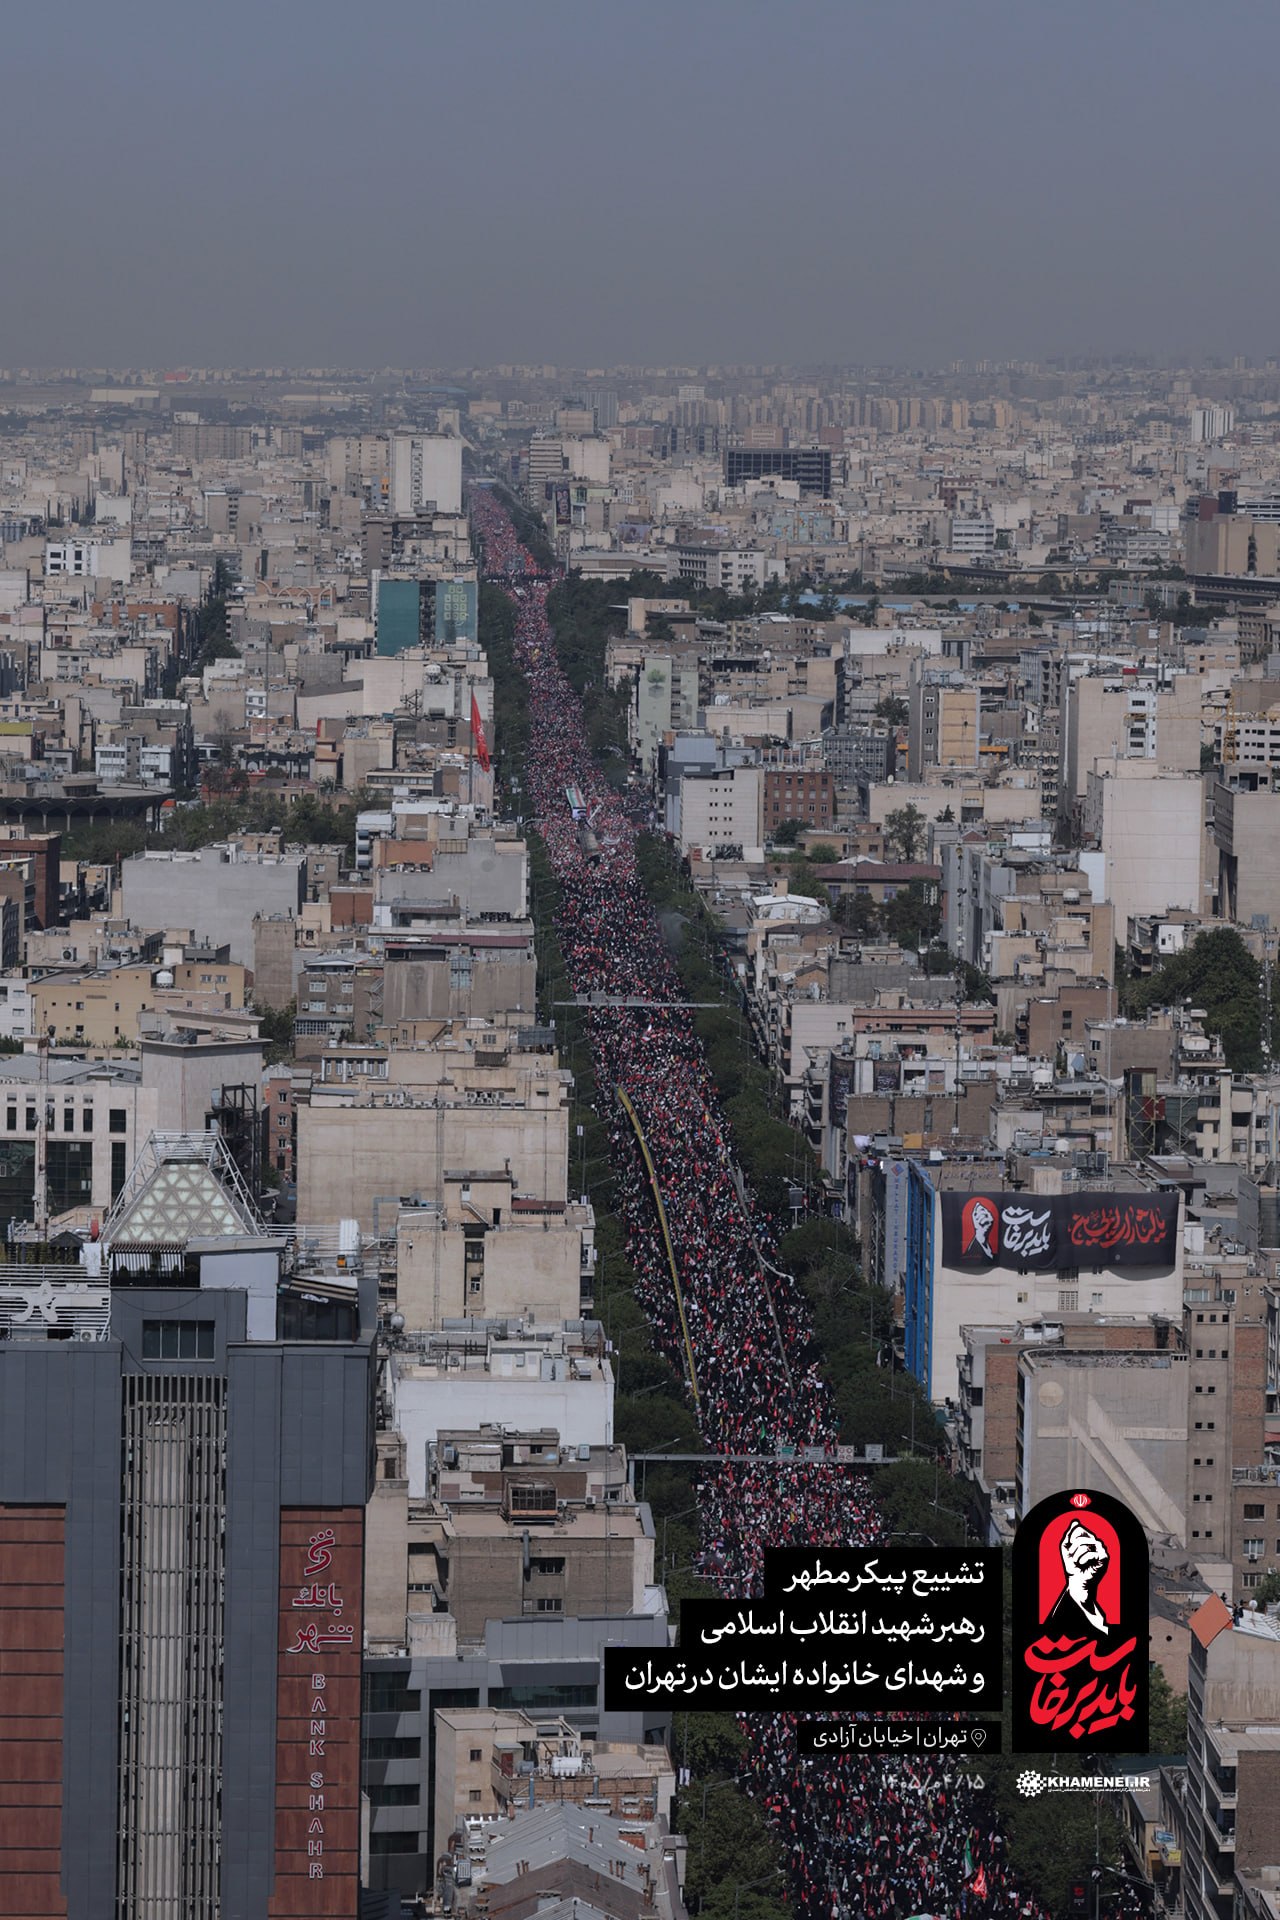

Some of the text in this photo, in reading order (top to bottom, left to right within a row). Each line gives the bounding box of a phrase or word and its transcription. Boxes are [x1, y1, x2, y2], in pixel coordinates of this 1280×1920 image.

[286, 1623, 354, 1653] شهر
[308, 1673, 326, 1879] BANK SHAHR
